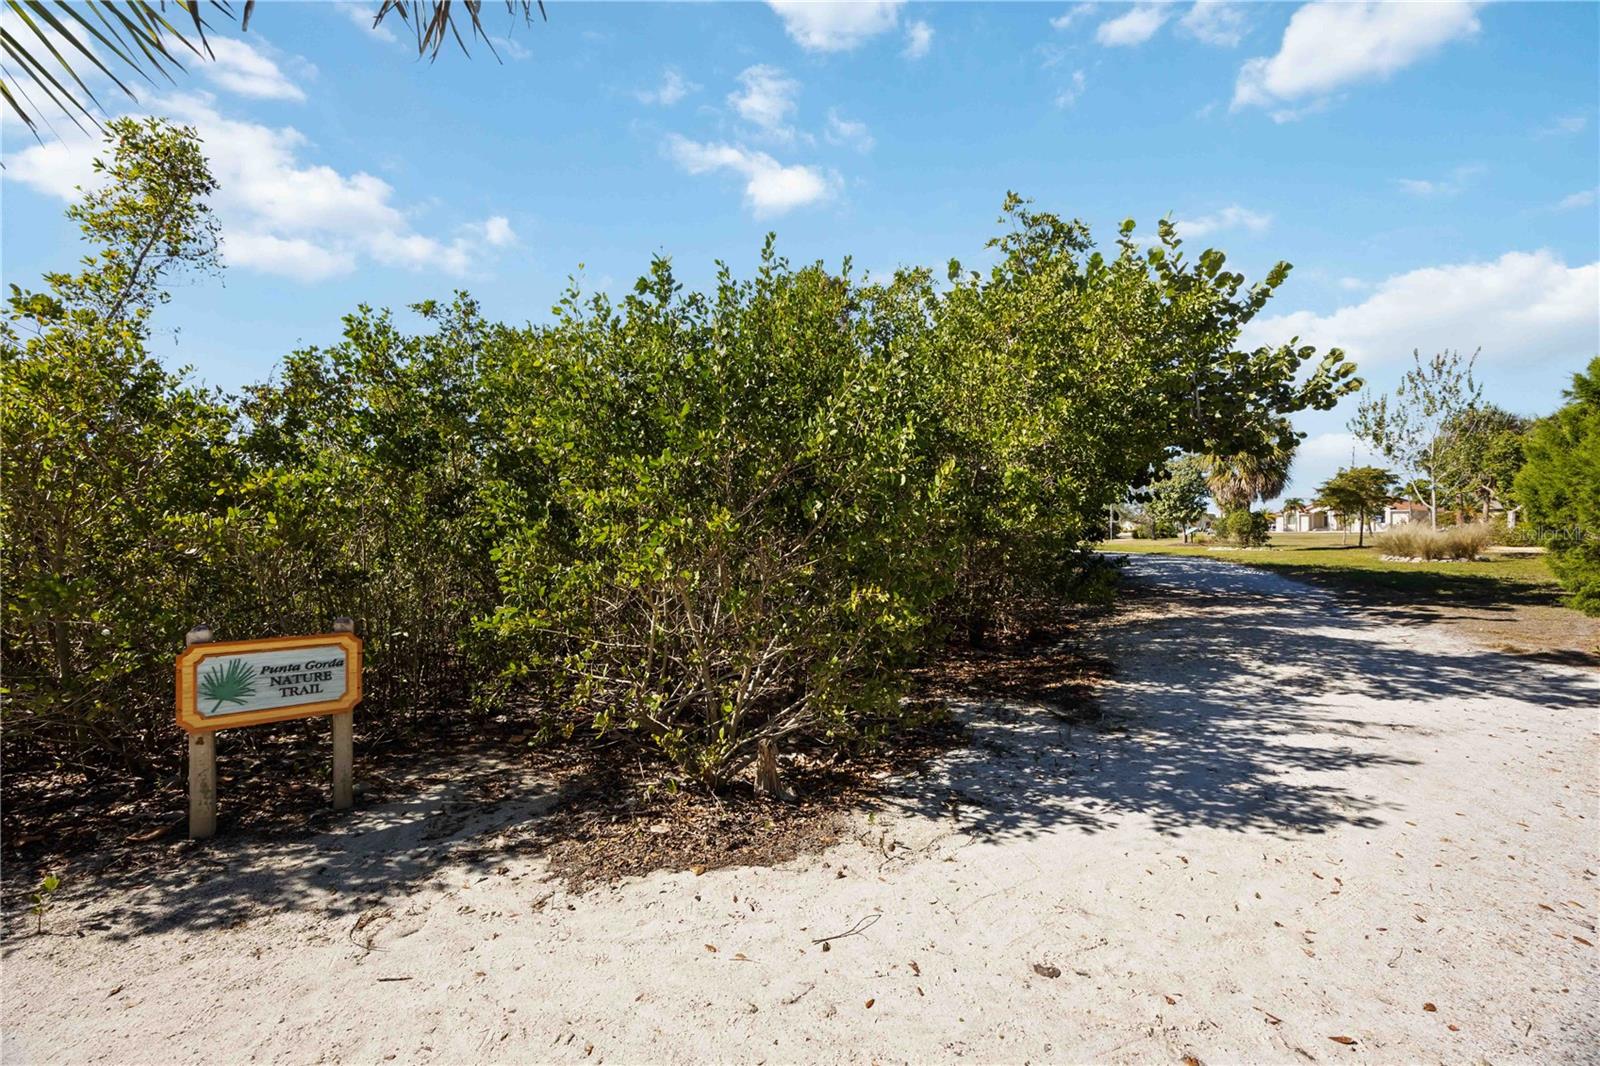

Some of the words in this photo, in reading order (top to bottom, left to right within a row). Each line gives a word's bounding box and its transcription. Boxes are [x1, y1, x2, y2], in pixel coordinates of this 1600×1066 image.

[260, 664, 301, 675] Punta
[305, 658, 344, 670] Gorda
[270, 670, 333, 687] NATURE
[279, 683, 324, 698] TRAIL
